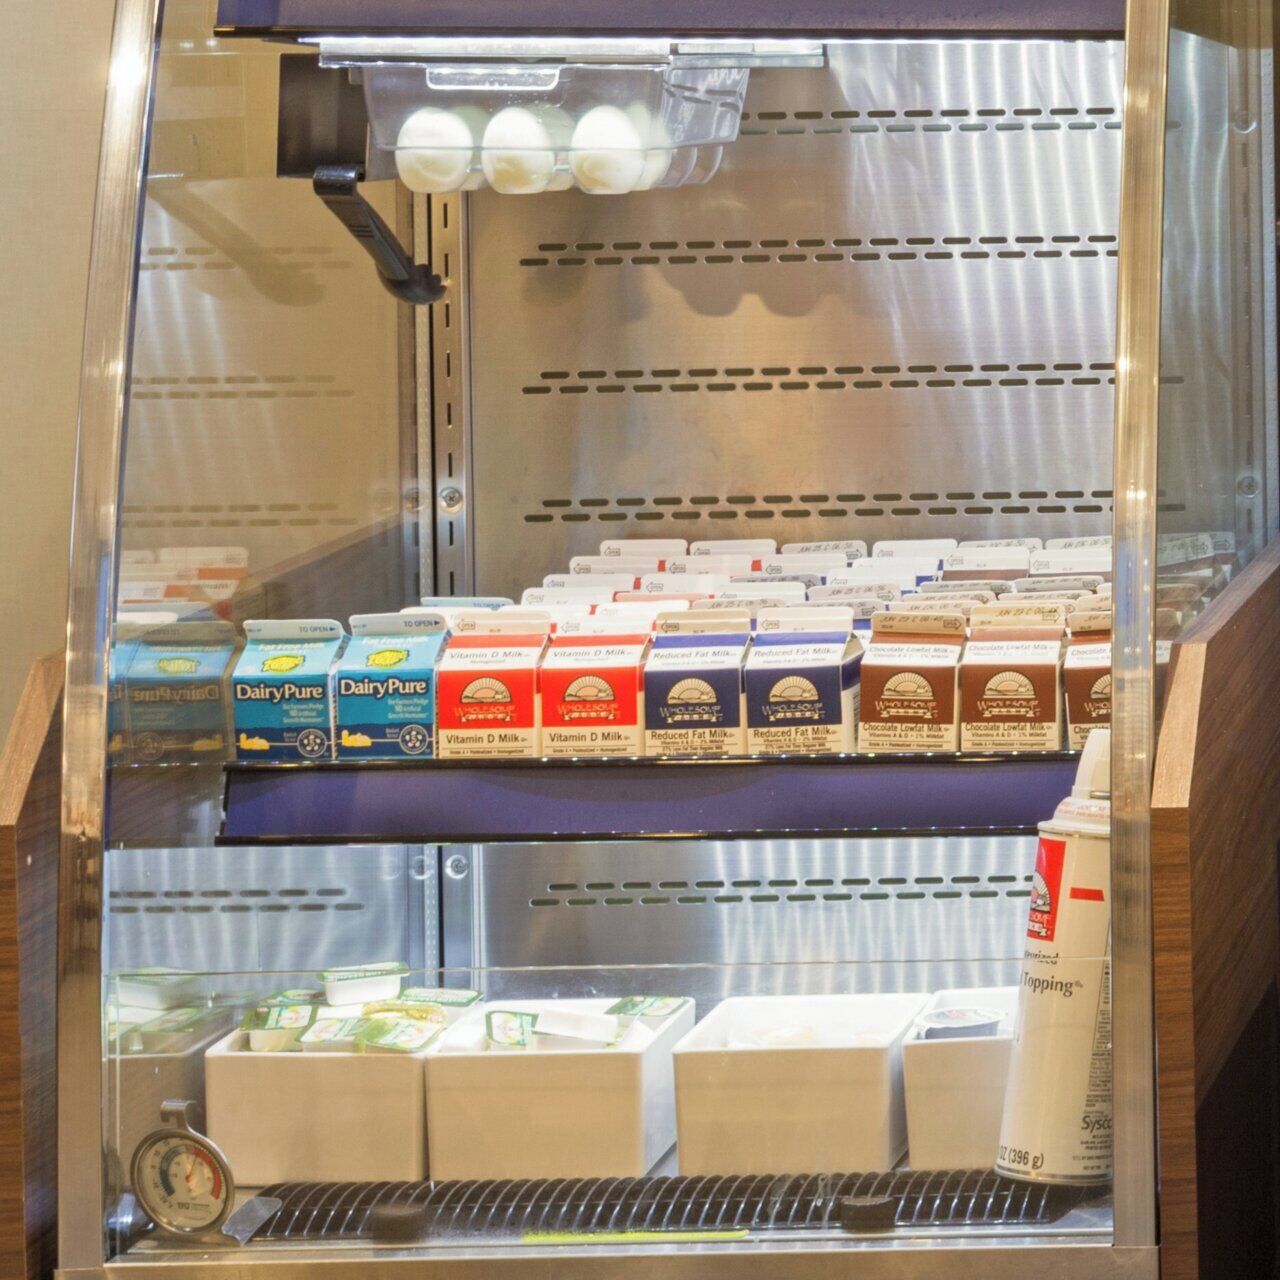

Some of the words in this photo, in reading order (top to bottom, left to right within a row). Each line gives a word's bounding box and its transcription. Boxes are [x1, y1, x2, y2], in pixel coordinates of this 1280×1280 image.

[414, 620, 433, 628] OPEN
[449, 649, 488, 659] Vitamin
[553, 649, 591, 658] Vitamin
[235, 683, 324, 702] DairyPure
[340, 678, 427, 698] DairyPure
[753, 728, 792, 739] Reduced
[795, 728, 808, 738] Fat
[812, 727, 831, 737] Milk
[863, 723, 899, 732] Chocolate
[900, 723, 925, 733] Lowfat
[927, 724, 942, 733] Milk
[965, 723, 1001, 732] Chocolate
[1003, 723, 1027, 732] Lowfat
[1029, 723, 1045, 732] Milk
[446, 733, 484, 744] Vitamin
[487, 733, 495, 743] D
[498, 732, 519, 743] Milk
[549, 733, 587, 743] Vitamin
[590, 732, 598, 742] D
[601, 732, 622, 742] Milk
[651, 730, 690, 740] Reduced
[692, 730, 706, 740] Fat
[709, 730, 728, 739] Milk
[1023, 971, 1075, 997] Topping
[1008, 1148, 1030, 1166] (396
[1032, 1153, 1045, 1170] g)
